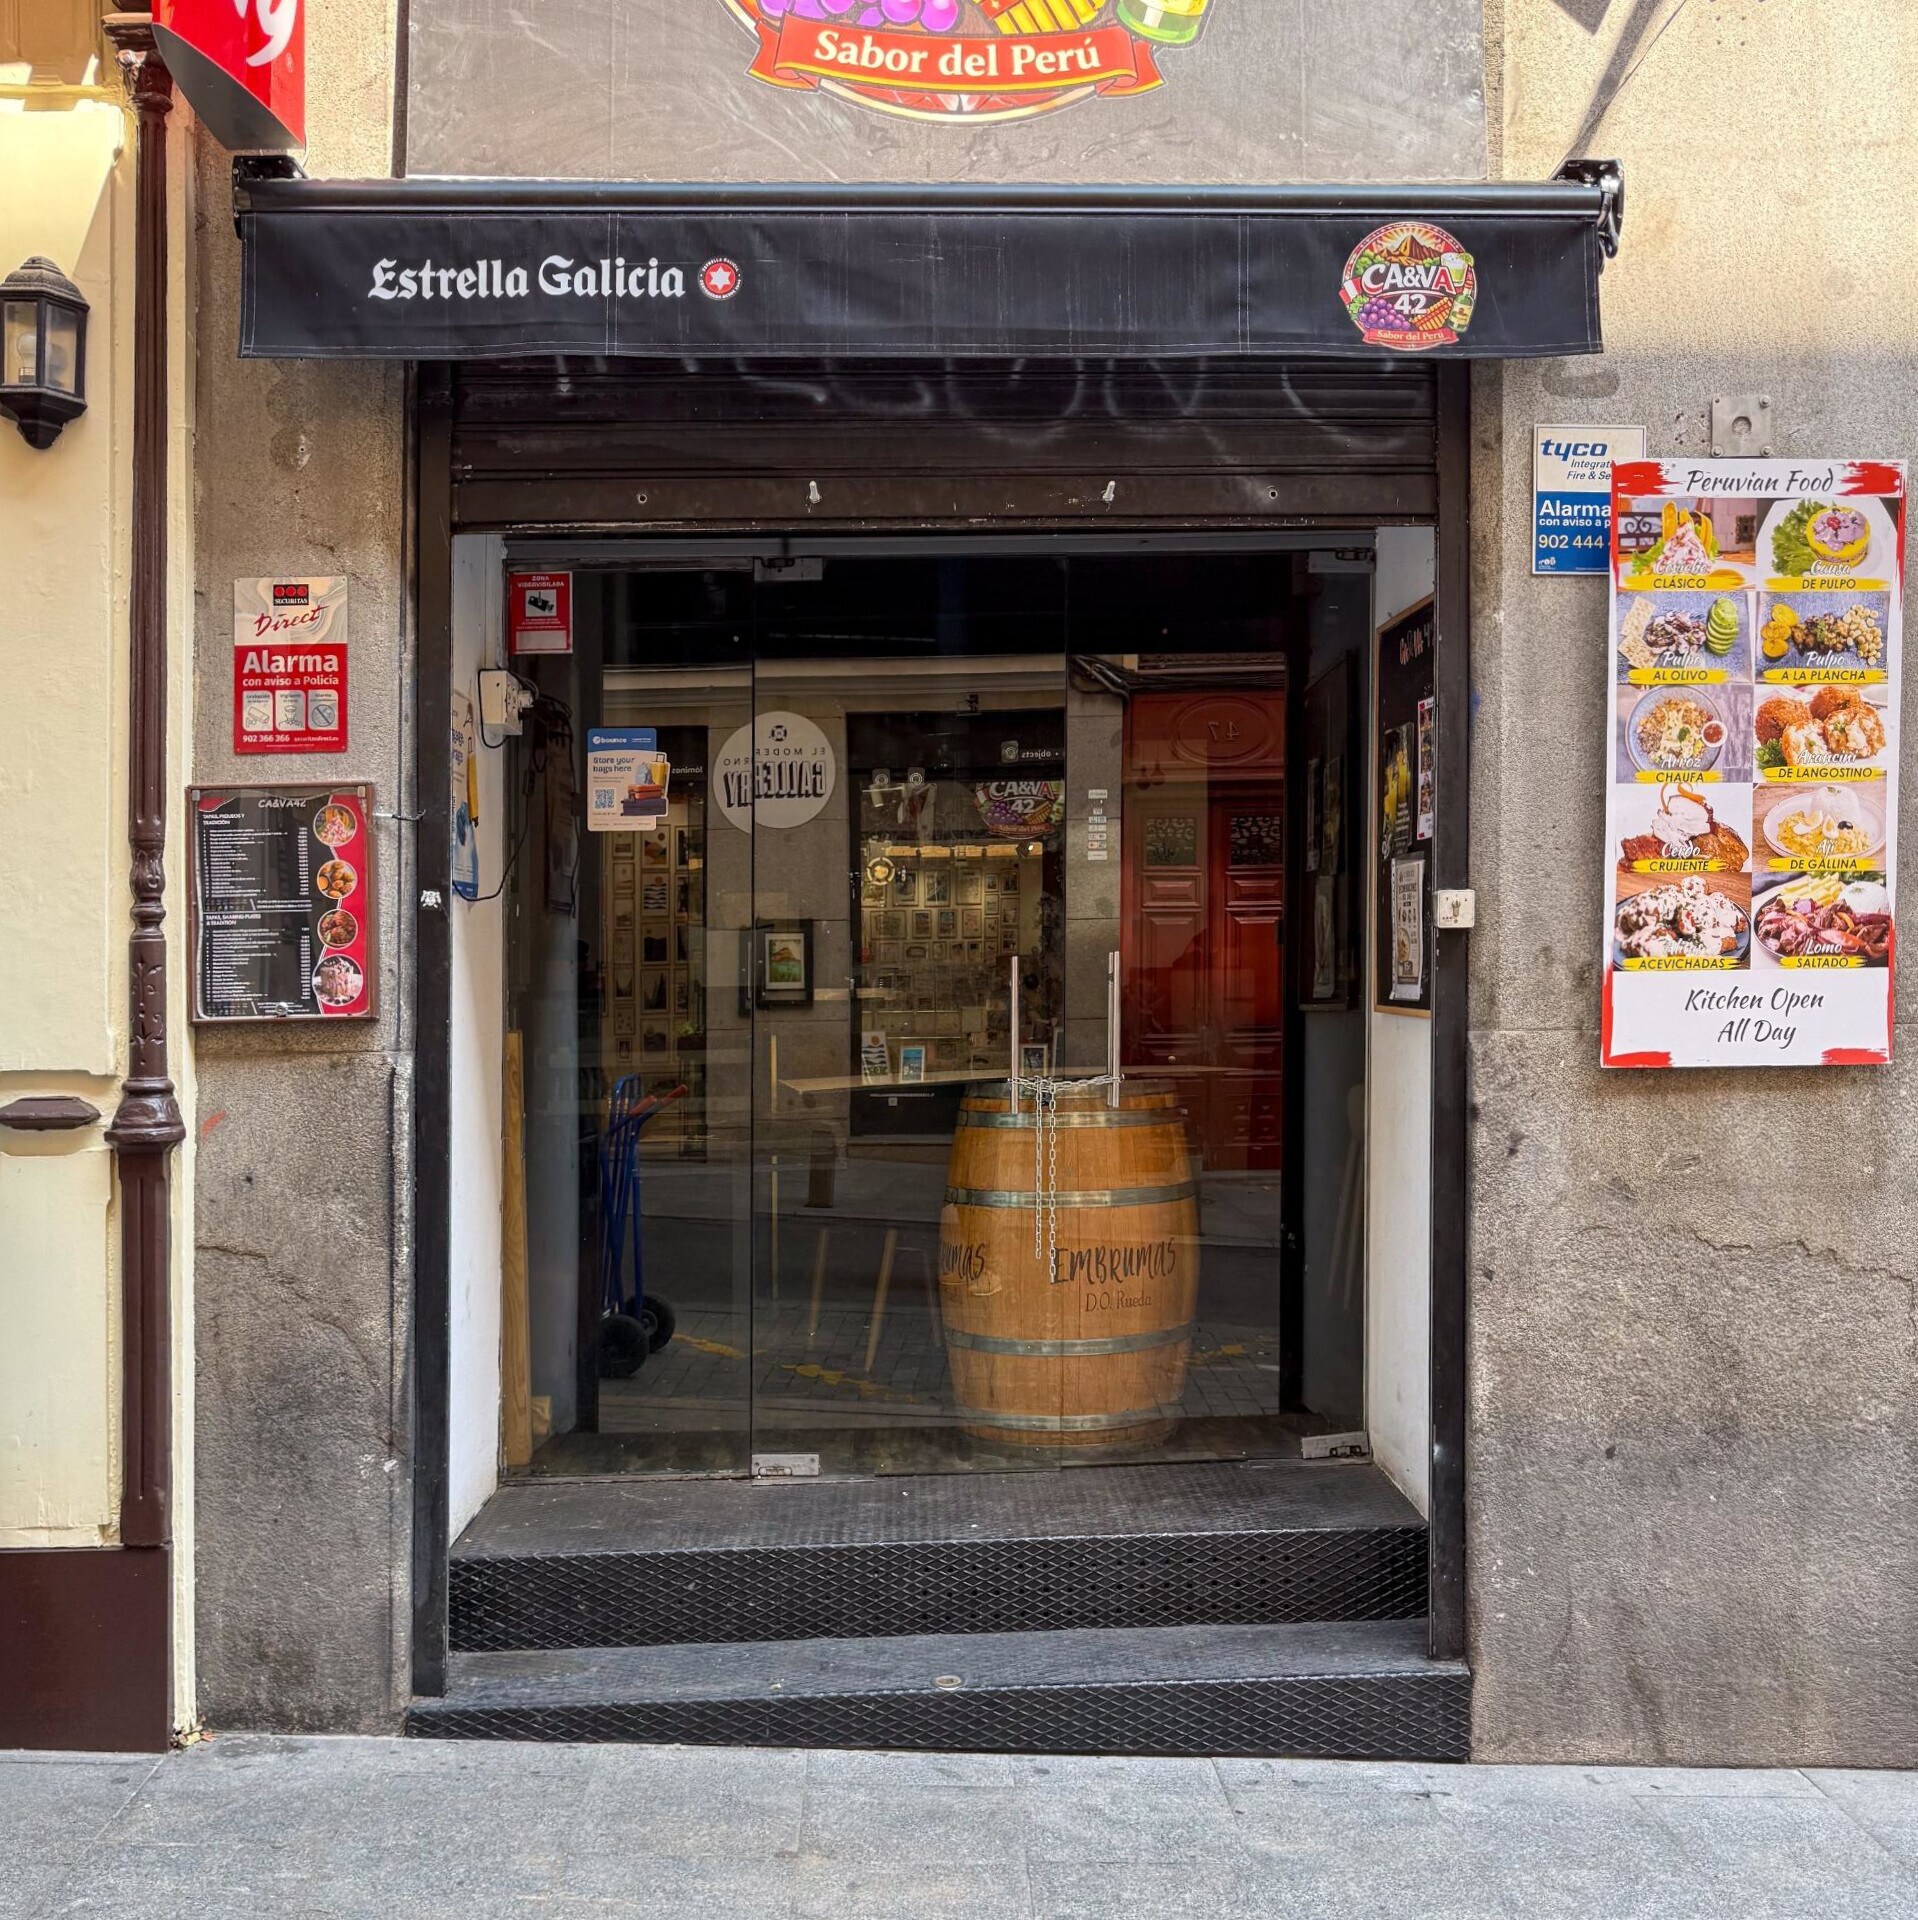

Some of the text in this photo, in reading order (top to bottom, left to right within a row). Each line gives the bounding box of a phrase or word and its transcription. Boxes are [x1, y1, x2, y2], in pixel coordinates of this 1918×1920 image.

[813, 29, 1102, 77] Sabor del Perú
[368, 257, 530, 300] Estrella
[538, 254, 686, 298] Galicia
[1361, 263, 1457, 295] CA&VA
[1394, 293, 1428, 315] 42
[1377, 329, 1404, 340] Sabor
[1405, 330, 1420, 341] del
[1540, 438, 1608, 461] tyco
[1566, 470, 1586, 480] Fire
[1587, 470, 1597, 480] &
[1685, 467, 1834, 493] Peruvian Food
[1539, 499, 1612, 517] Alarma
[1538, 518, 1560, 526] con
[1562, 516, 1593, 527] aviso
[1594, 518, 1602, 527] a
[1538, 534, 1604, 549] 902 444
[1810, 558, 1850, 575] Causa
[1653, 575, 1706, 589] CLÁSICO
[1801, 578, 1856, 590] DE PULPO
[254, 604, 330, 637] Direct
[242, 649, 339, 674] Alarma
[1662, 649, 1702, 670] Pulpo
[1806, 649, 1845, 670] Pulpo
[242, 674, 339, 686] con aviso a Policía
[1653, 670, 1708, 681] AL OLIVO
[1781, 669, 1867, 681] A LA PLANCHA
[242, 734, 291, 743] 902 366 366
[593, 756, 635, 765] Store your
[1660, 753, 1702, 769] Arroz
[593, 765, 613, 774] bags
[1778, 767, 1873, 779] DE LANGOSTINO
[1655, 771, 1704, 783] CHAUFA
[1010, 800, 1036, 814] 42
[1661, 840, 1701, 860] Cerdo
[1649, 859, 1709, 871] CRUJIENTE
[1790, 858, 1857, 869] DE GALLINA
[1805, 941, 1842, 955] Lomo
[1638, 958, 1725, 970] ACEVICHADAS
[1796, 957, 1849, 968] SALTADO
[1685, 985, 1824, 1017] Kitchen Open
[1717, 1018, 1797, 1049] All Day
[1116, 1289, 1152, 1310] Rueda
